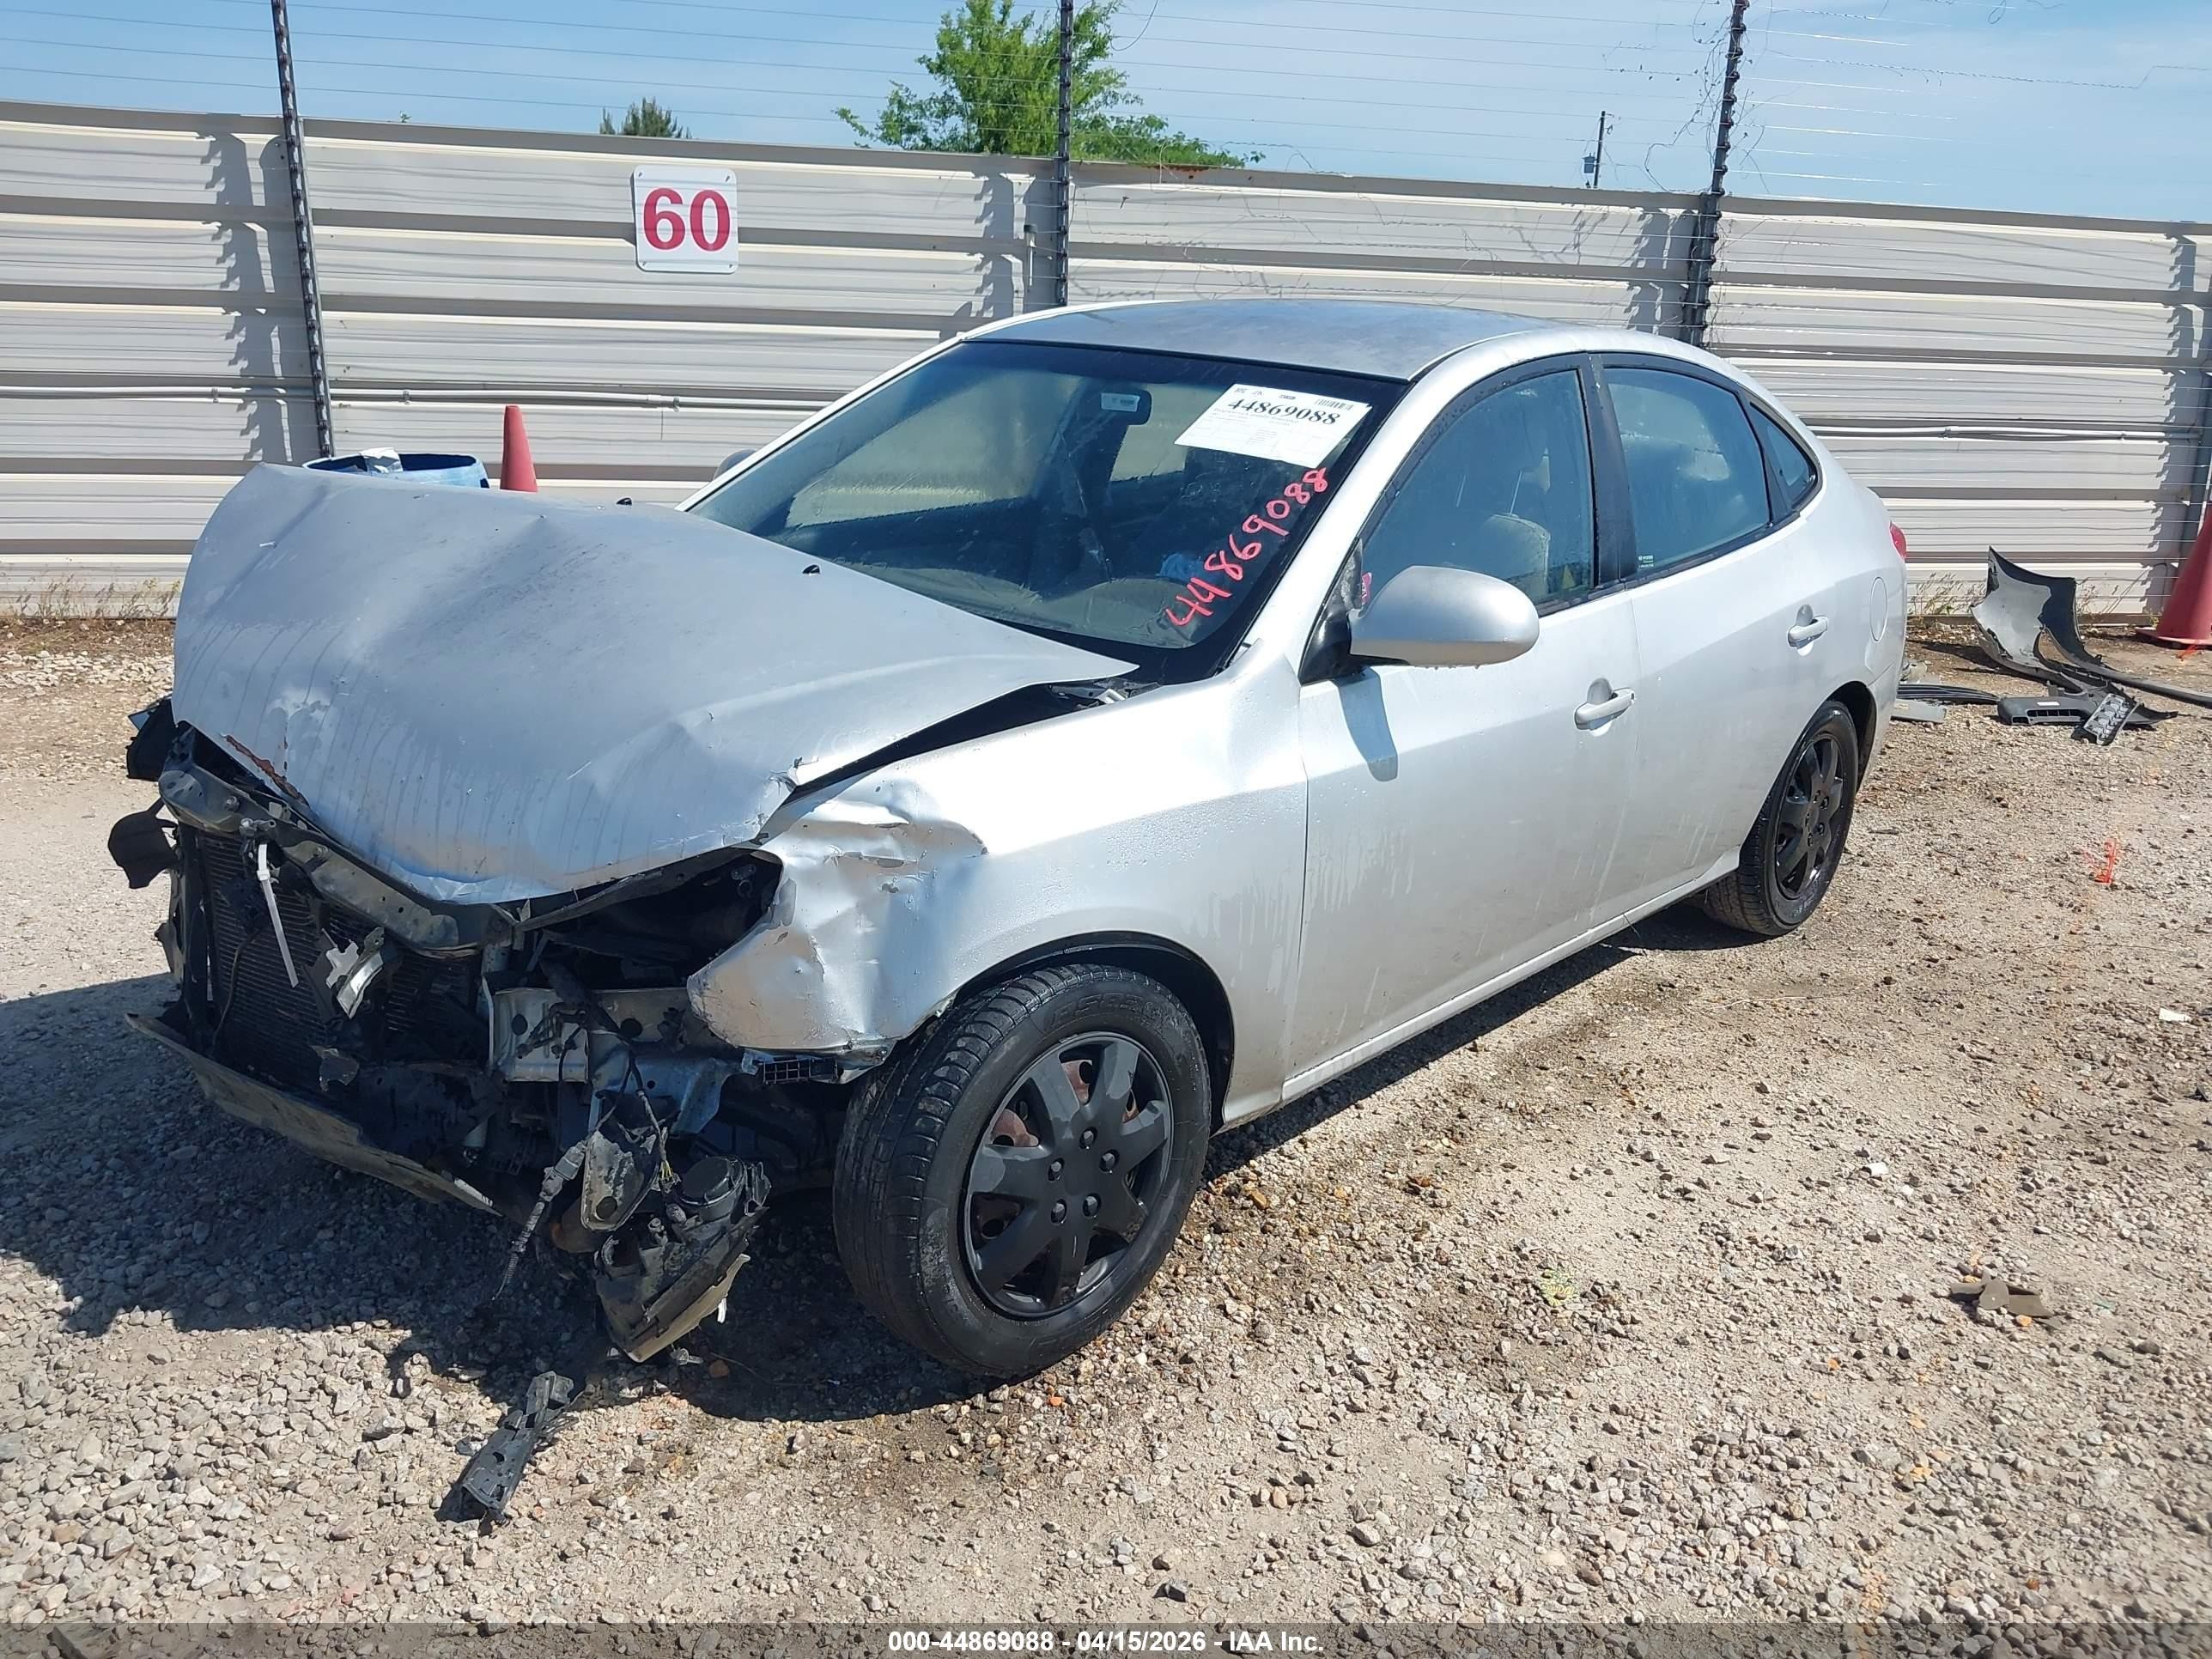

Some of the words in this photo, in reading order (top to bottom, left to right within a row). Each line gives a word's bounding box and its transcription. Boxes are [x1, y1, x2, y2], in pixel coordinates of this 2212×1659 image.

[643, 187, 731, 252] 60
[1228, 398, 1341, 425] 44869088
[1165, 467, 1328, 626] 44869088
